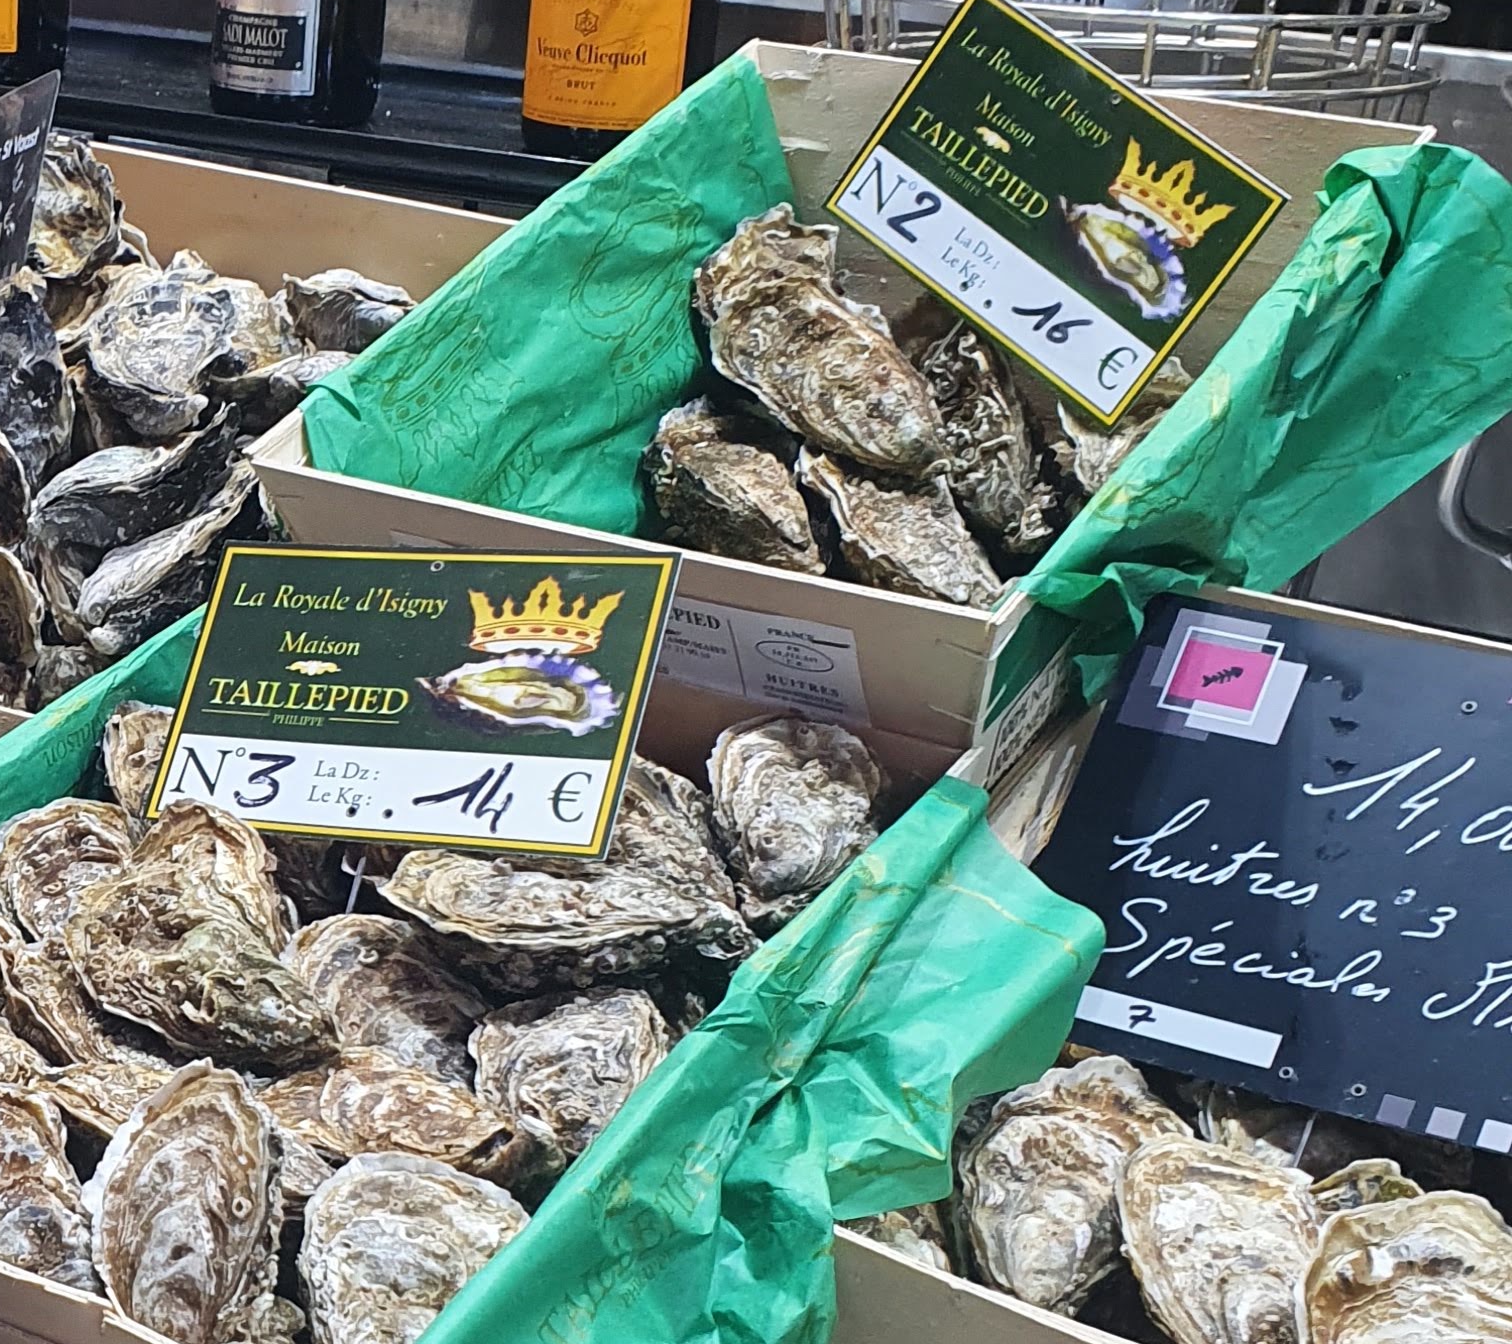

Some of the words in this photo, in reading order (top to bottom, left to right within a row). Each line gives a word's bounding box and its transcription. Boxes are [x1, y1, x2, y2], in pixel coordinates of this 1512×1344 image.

[245, 23, 290, 50] MALOT
[535, 35, 573, 64] Veuve
[574, 41, 648, 73] Clicquot
[565, 77, 597, 92] BRUT
[959, 26, 987, 59] La
[986, 48, 1049, 104] Royale
[1044, 86, 1114, 150] d'Isigny
[975, 91, 1037, 147] Maison
[908, 106, 1051, 222] TAILLEPIED
[953, 226, 977, 249] La
[940, 246, 961, 269] Le
[1010, 300, 1095, 346] 16
[1096, 345, 1139, 391] €
[232, 582, 267, 609] La
[273, 584, 351, 616] Royale
[355, 589, 449, 621] d'Isigny
[277, 629, 361, 657] Maison
[206, 676, 411, 718] TAILLEPIED
[271, 712, 325, 729] PHILIPPE
[232, 751, 297, 808] 3
[314, 759, 342, 780] La
[307, 784, 331, 804] Le
[412, 761, 515, 835] 14
[546, 770, 595, 825] €
[1109, 798, 1320, 907] huitres
[1101, 896, 1392, 1004] Spéciales
